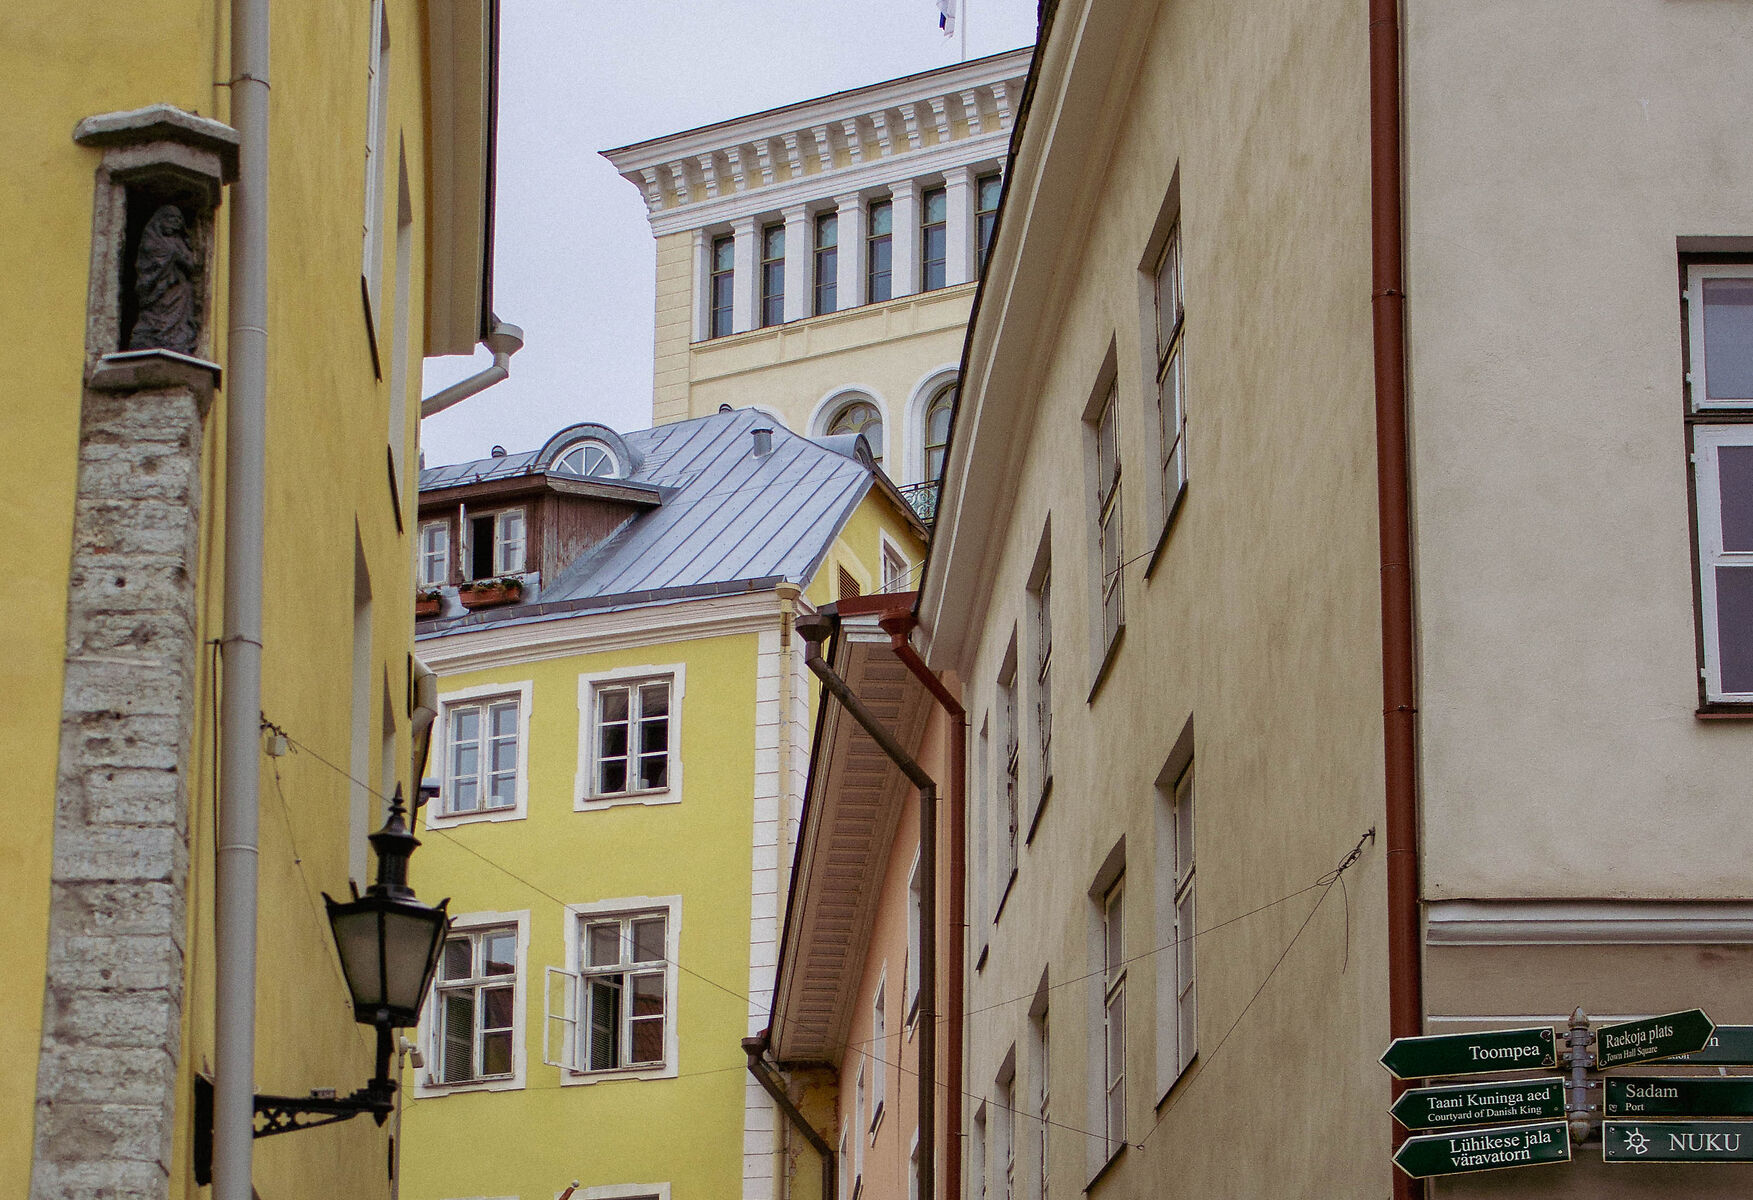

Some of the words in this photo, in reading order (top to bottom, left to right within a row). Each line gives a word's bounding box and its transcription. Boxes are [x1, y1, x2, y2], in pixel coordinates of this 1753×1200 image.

[1605, 1027, 1646, 1048] Raekoja
[1648, 1024, 1674, 1044] plats
[1469, 1045, 1540, 1061] Toompea
[1606, 1052, 1623, 1062] Town
[1623, 1048, 1636, 1059] Hall
[1637, 1045, 1658, 1057] Square
[1427, 1095, 1463, 1110] Taani
[1467, 1091, 1523, 1106] Kuninga
[1527, 1088, 1550, 1100] aed
[1626, 1084, 1678, 1098] Sadam
[1428, 1110, 1472, 1122] Courtyard
[1474, 1109, 1484, 1118] of
[1486, 1106, 1517, 1117] Danish
[1519, 1105, 1542, 1116] King
[1625, 1103, 1645, 1111] Port
[1450, 1135, 1520, 1153] Lühikese
[1524, 1130, 1551, 1148] jala
[1668, 1133, 1742, 1151] NUKU
[1451, 1149, 1531, 1167] väravatorn
